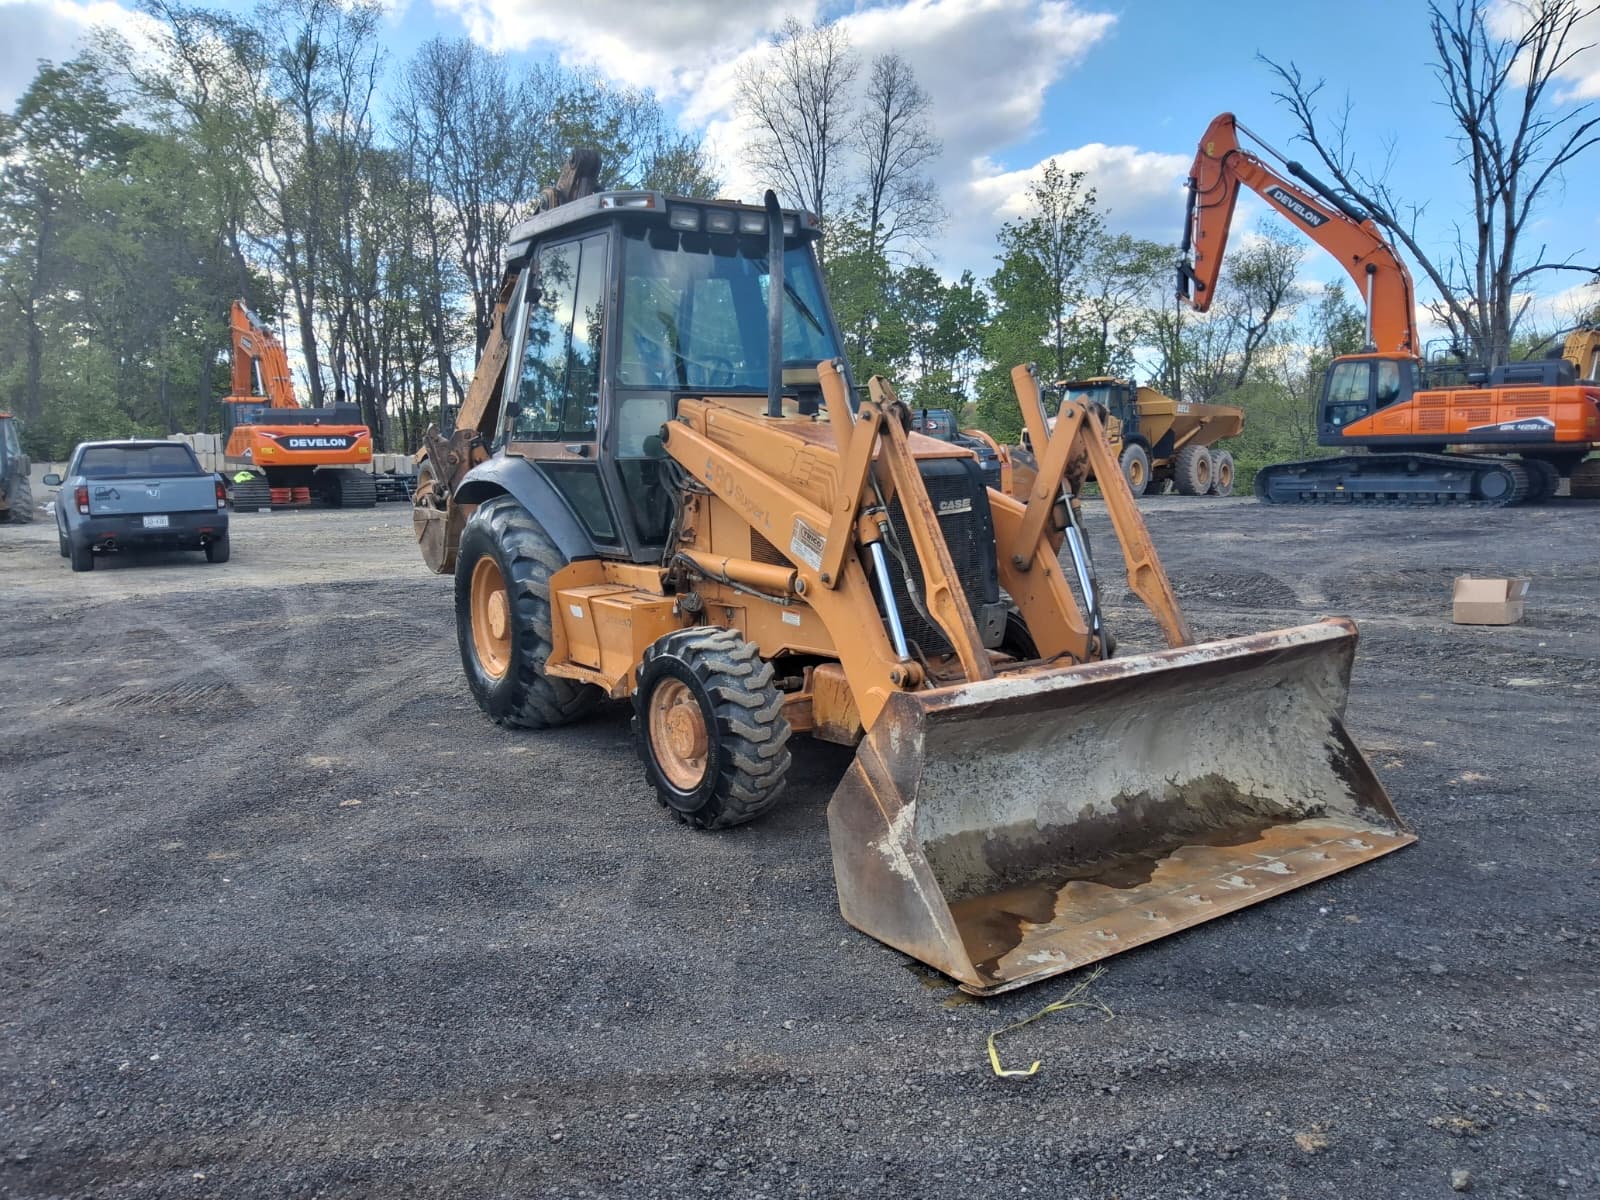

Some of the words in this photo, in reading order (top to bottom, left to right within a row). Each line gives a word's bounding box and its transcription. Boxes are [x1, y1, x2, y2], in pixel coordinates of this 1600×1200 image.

[1273, 190, 1321, 226] DEVELON
[289, 438, 346, 448] DEVELON
[939, 498, 971, 510] CASE
[803, 530, 822, 548] TRICO
